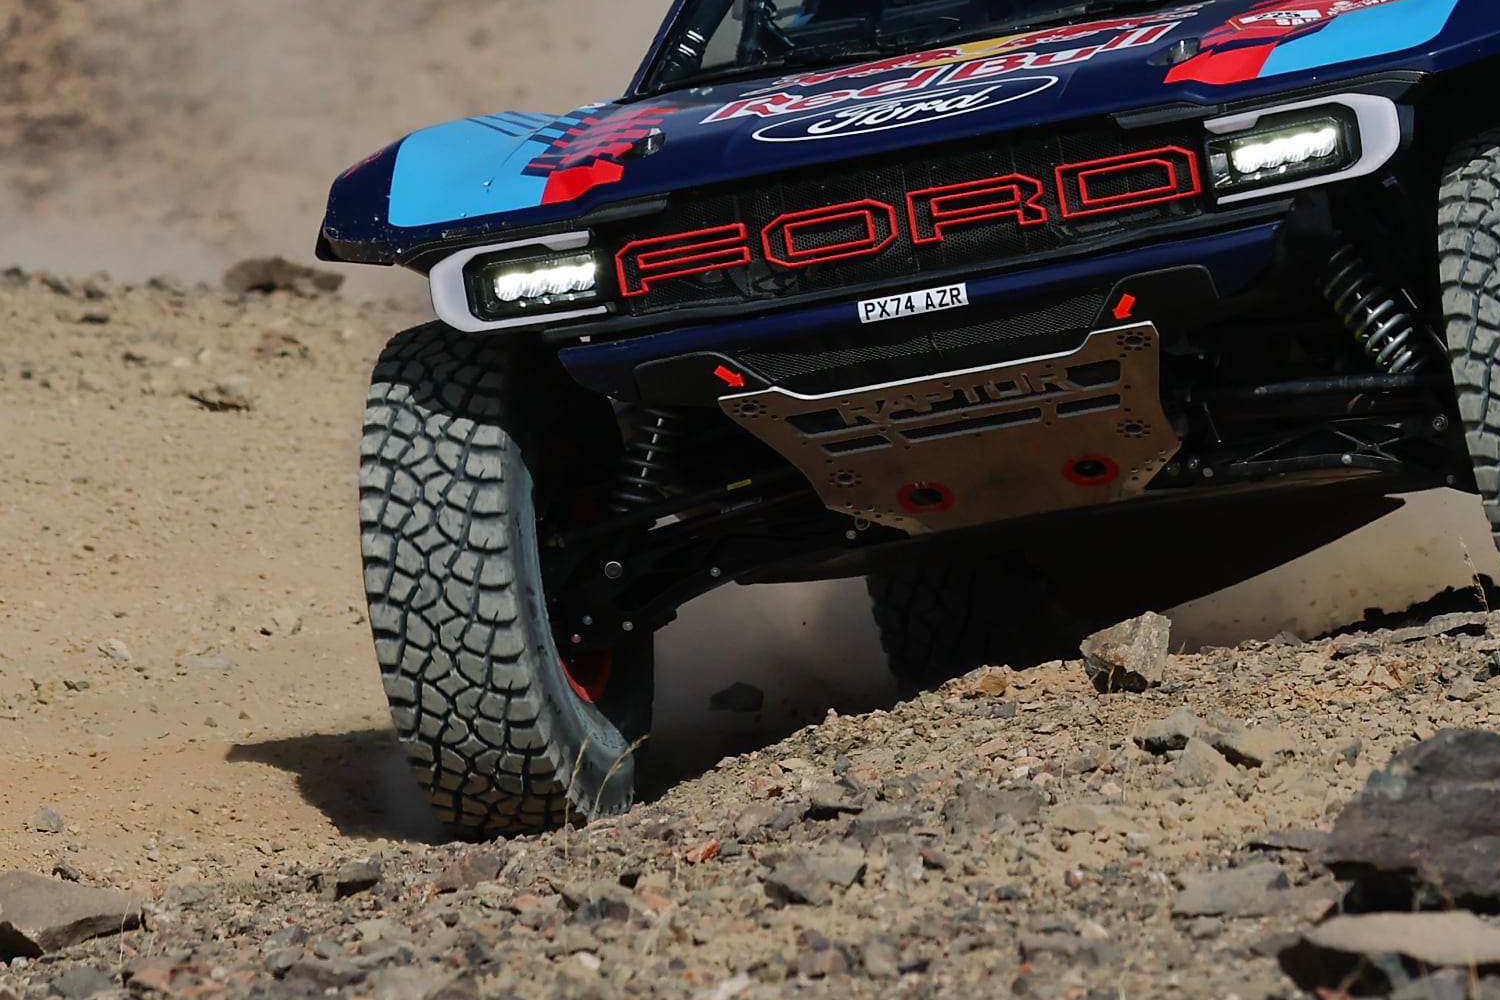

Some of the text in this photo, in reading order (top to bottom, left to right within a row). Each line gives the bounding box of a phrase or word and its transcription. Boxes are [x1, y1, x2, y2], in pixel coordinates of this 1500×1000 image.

[699, 21, 1182, 125] Red Bull
[807, 85, 1003, 134] Ford
[614, 145, 1201, 297] FORD
[864, 287, 963, 320] PX74 AZR
[836, 371, 1076, 426] RAPTOR
